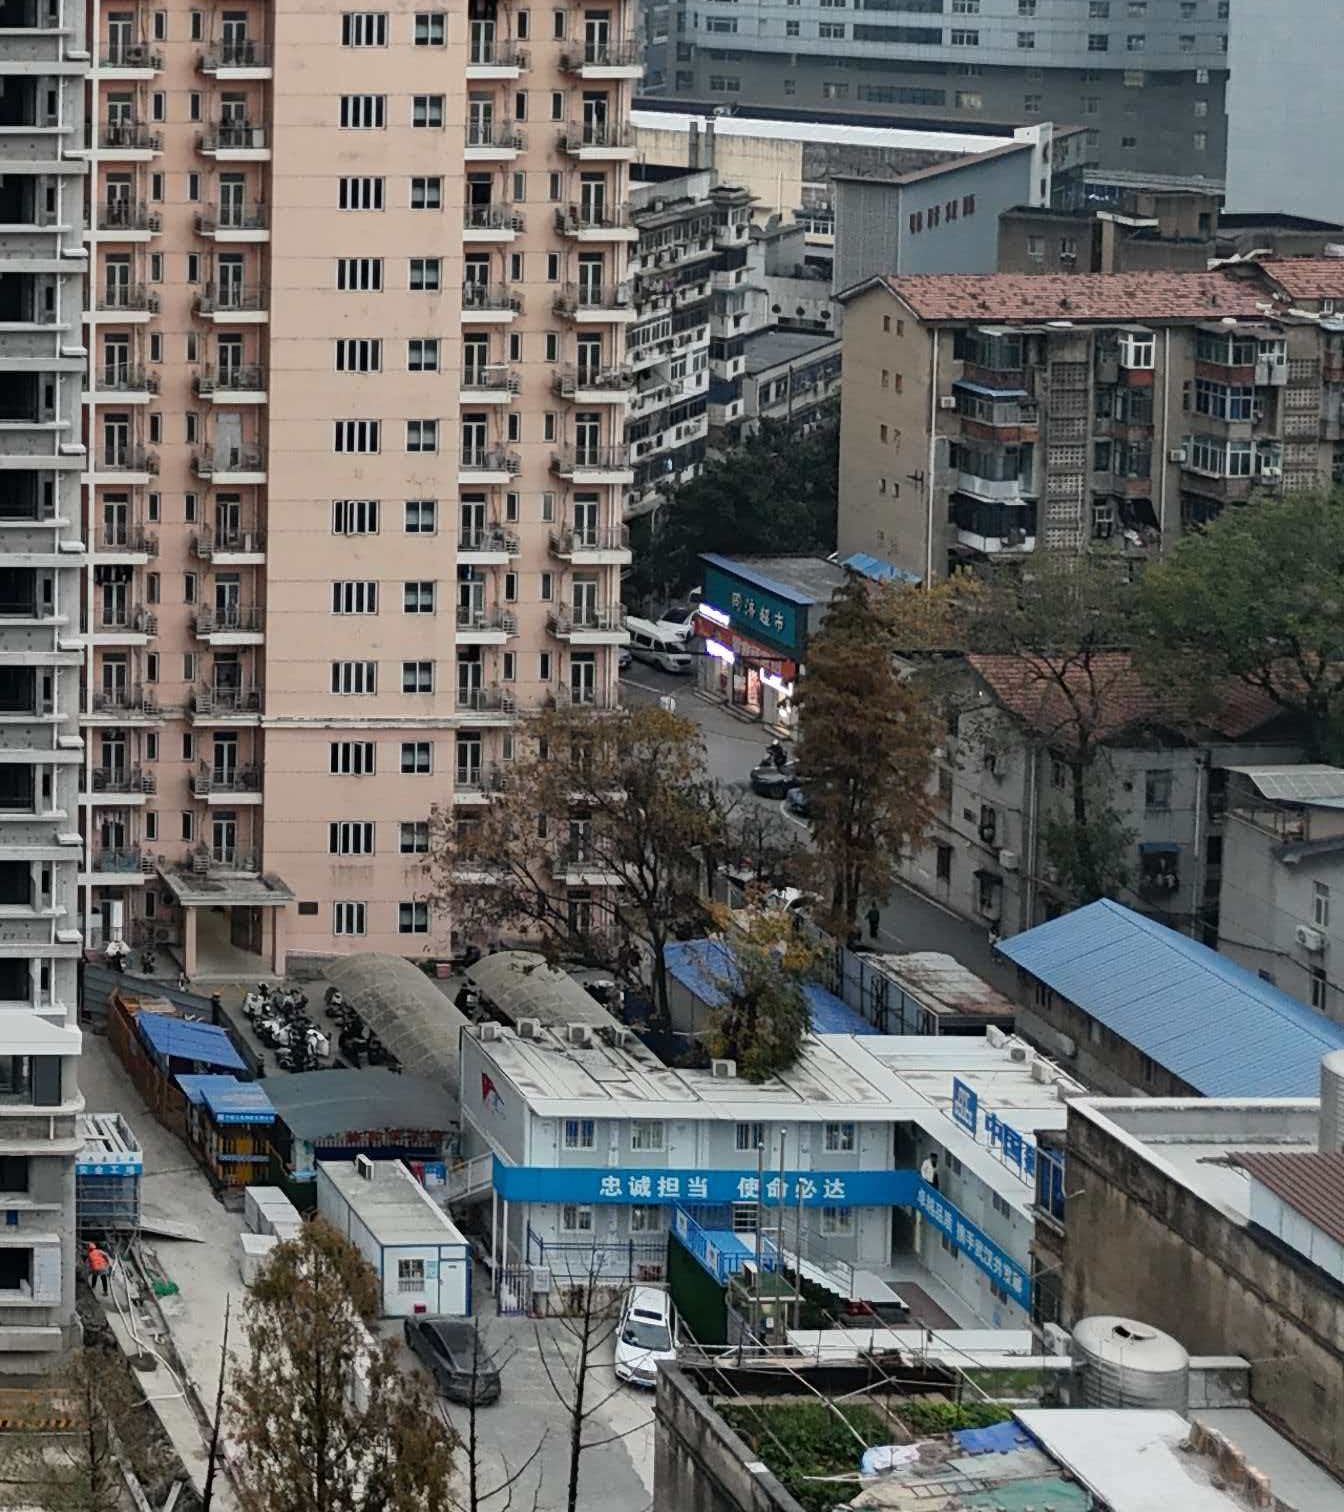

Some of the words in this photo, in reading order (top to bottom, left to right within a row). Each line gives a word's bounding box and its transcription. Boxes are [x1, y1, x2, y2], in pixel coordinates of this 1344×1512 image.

[599, 1175, 709, 1199] 忠诚担当
[737, 1176, 846, 1200] 使命必达
